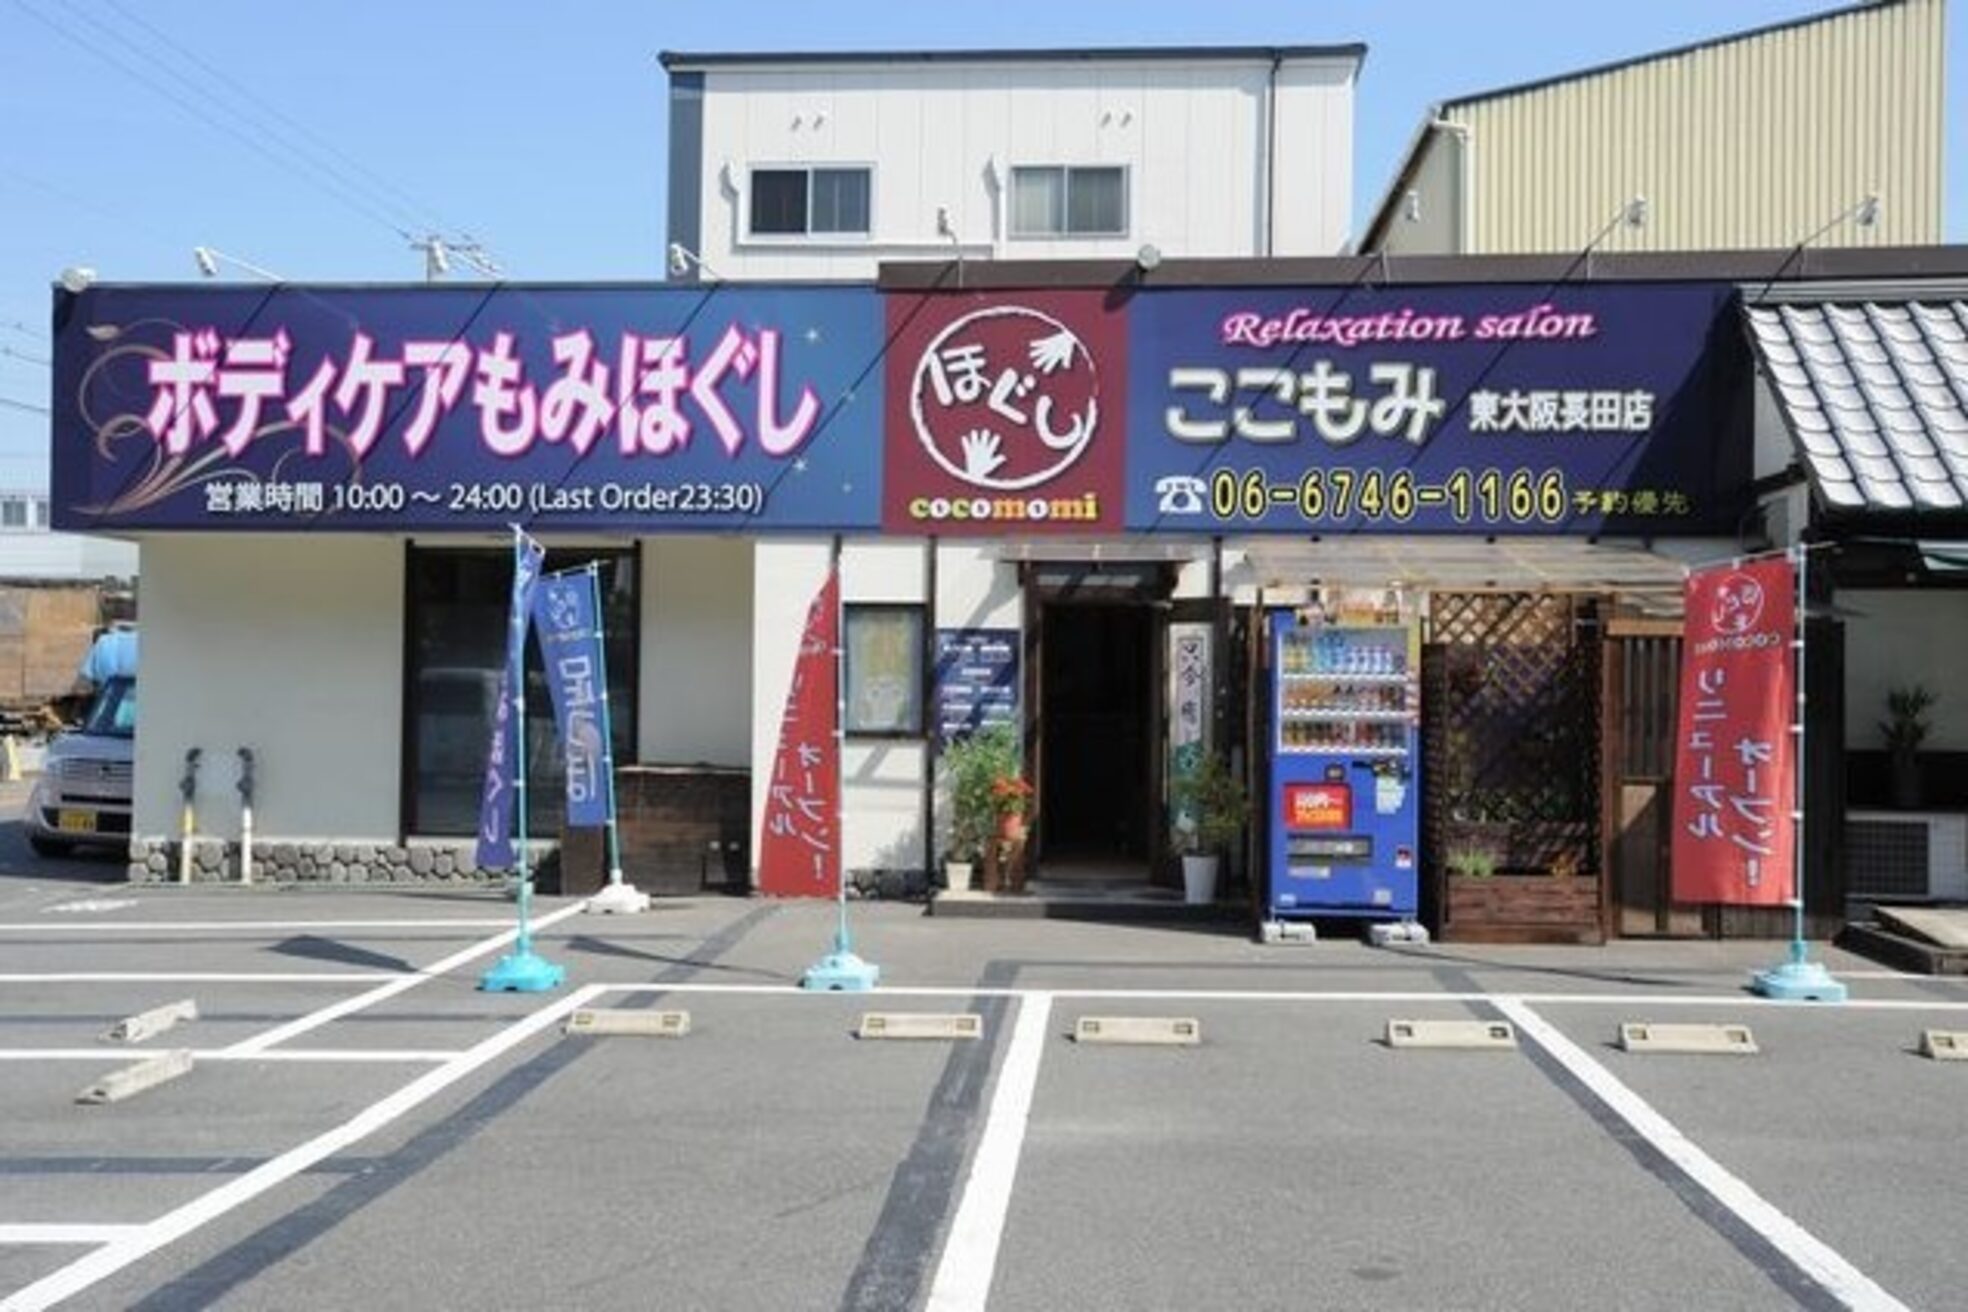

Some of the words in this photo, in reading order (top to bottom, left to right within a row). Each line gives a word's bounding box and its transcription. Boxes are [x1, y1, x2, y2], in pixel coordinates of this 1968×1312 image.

[1222, 308, 1465, 347] Relaxation
[1475, 303, 1597, 339] salon
[145, 325, 821, 458] ボディケアもみほぐし
[929, 343, 1084, 450] ほぐし
[1165, 360, 1446, 445] ここもみ
[1469, 389, 1655, 431] 東大阪長田店
[205, 481, 324, 513] 営業時間
[332, 483, 404, 511] 10:00
[448, 483, 522, 511] 24:00
[530, 483, 594, 513] (Last
[599, 483, 763, 514] Order23:30)
[909, 493, 1098, 519] cocomomi
[1211, 466, 1568, 523] 06-6746-1166
[1571, 489, 1692, 515] 予約優先
